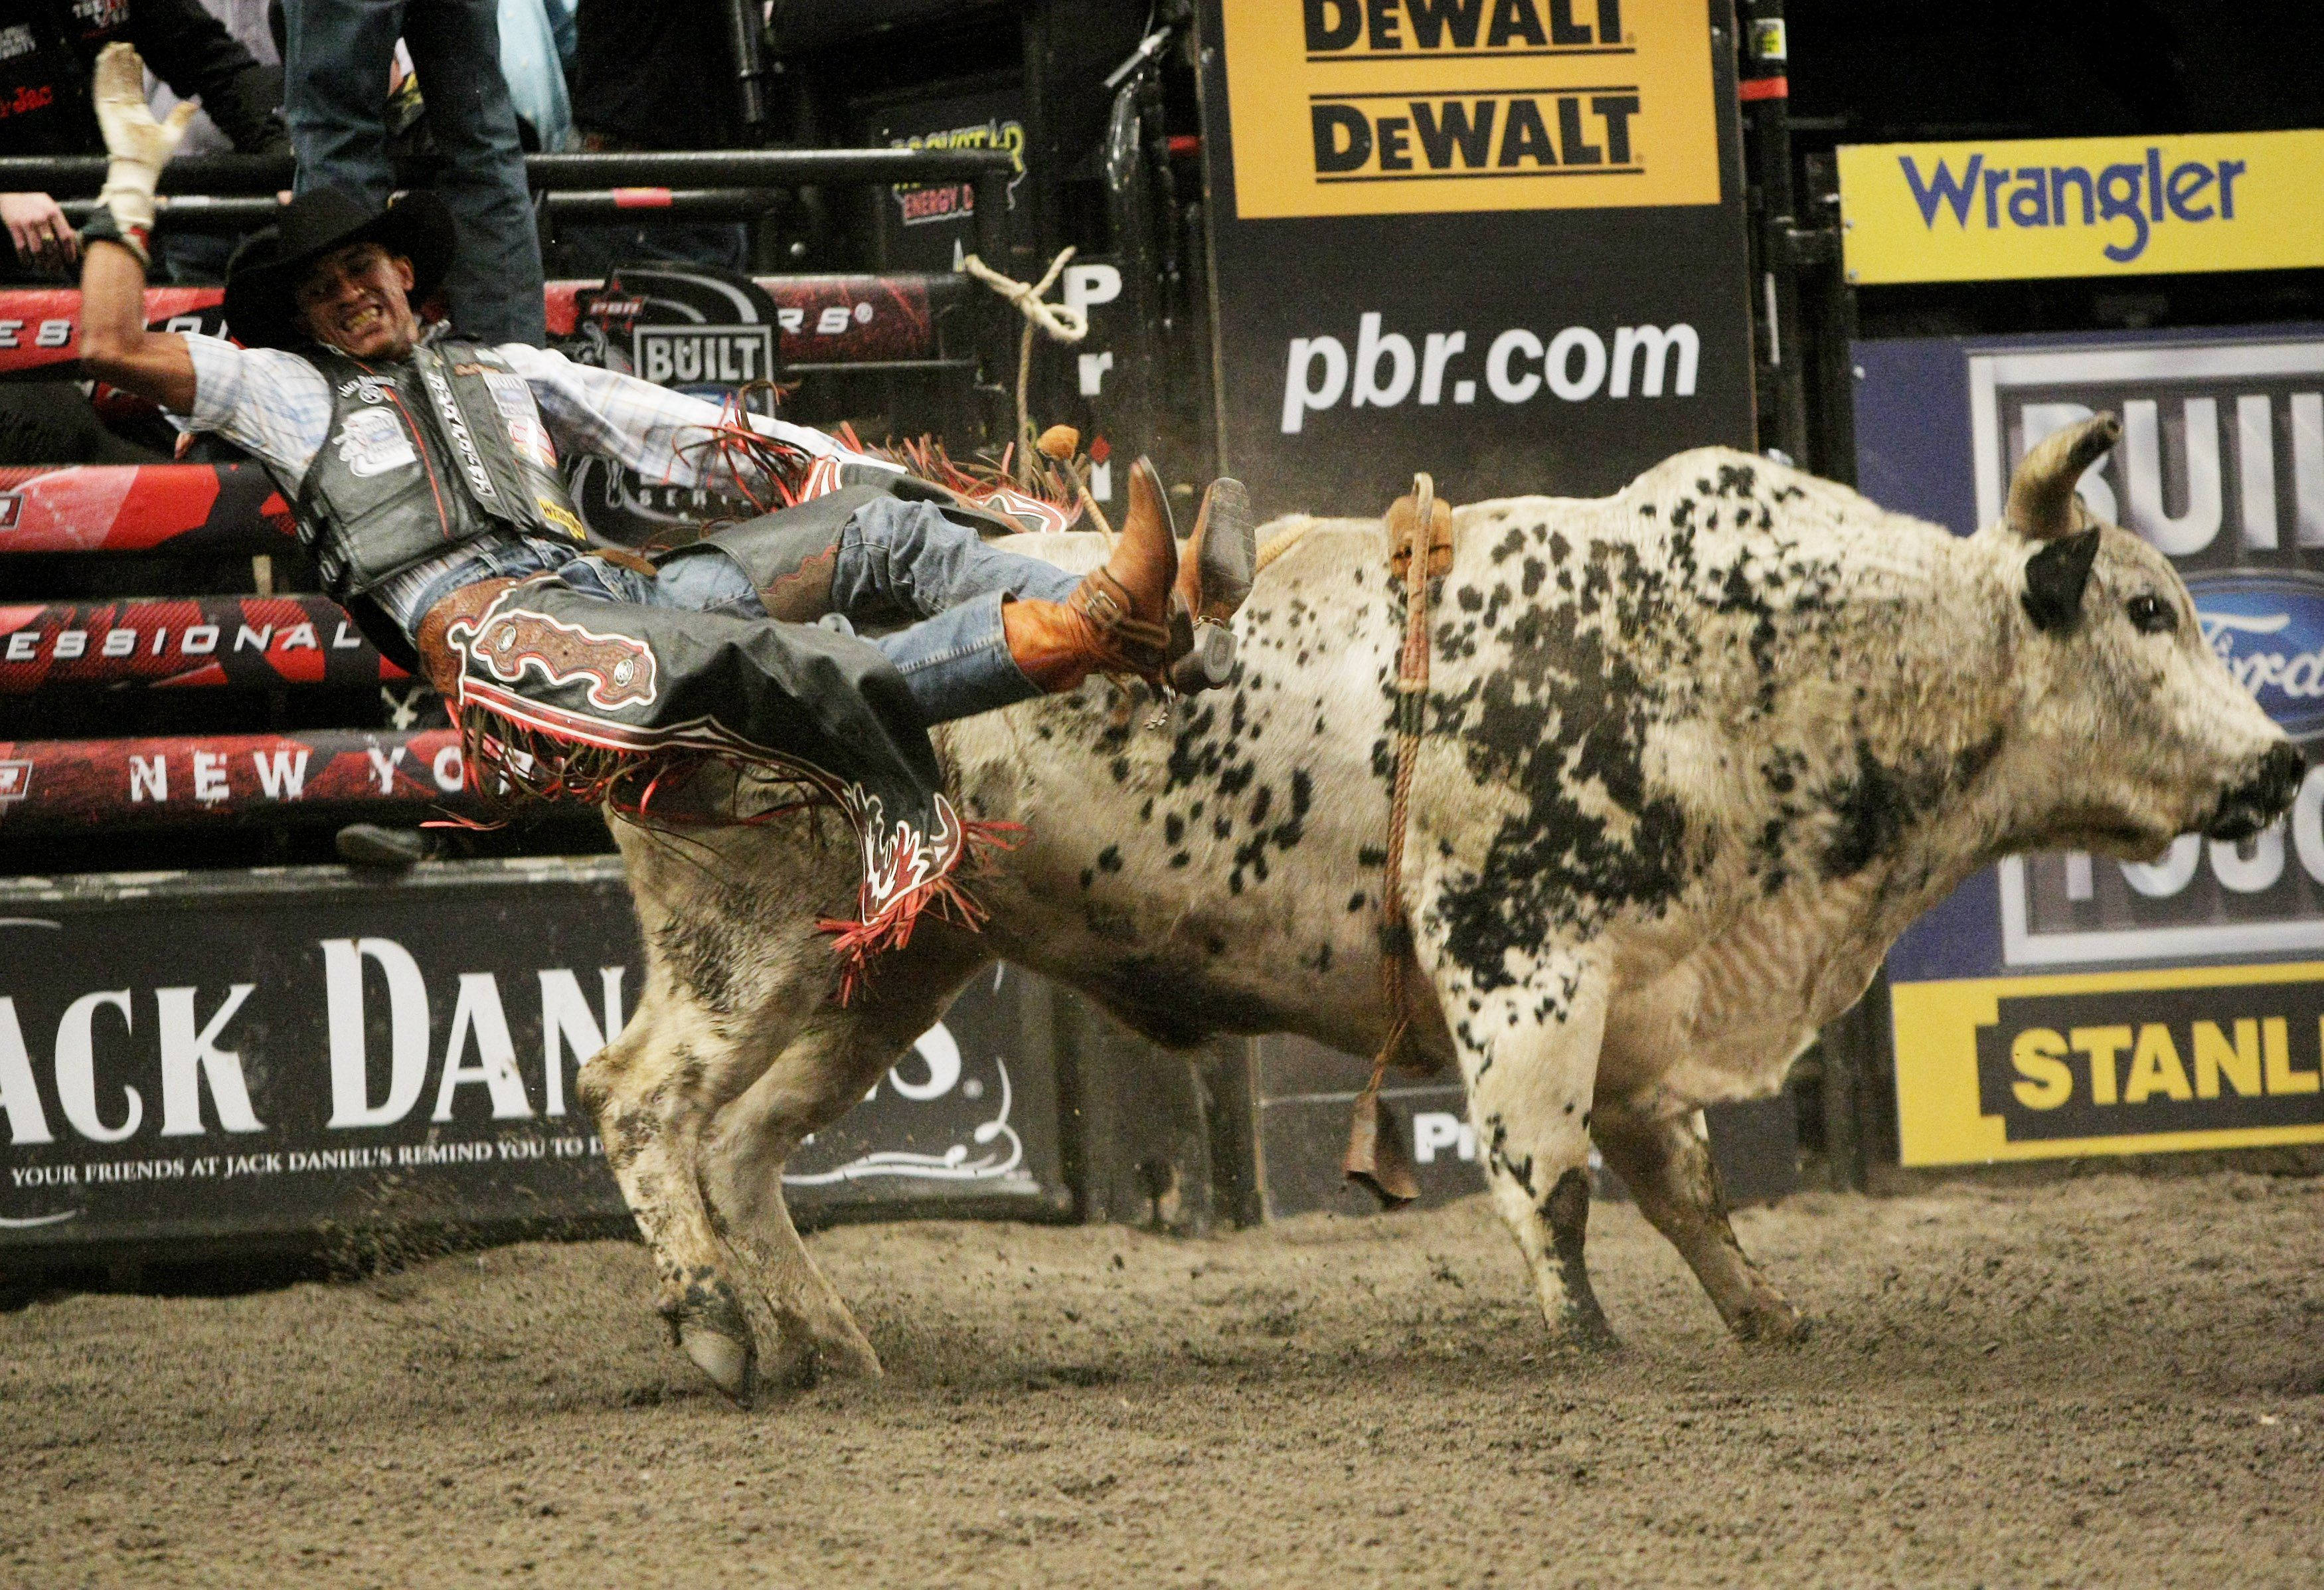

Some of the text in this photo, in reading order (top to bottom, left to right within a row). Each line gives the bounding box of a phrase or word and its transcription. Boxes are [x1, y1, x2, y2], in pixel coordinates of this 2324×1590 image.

[904, 187, 959, 219] ENERGY
[1898, 147, 2246, 263] Wrangler
[646, 335, 761, 381] BUILT
[1281, 312, 1700, 434] pbr.com
[5, 622, 362, 661] ESSIONAL
[129, 747, 309, 806] NEW
[2011, 1014, 2324, 1111] STANL
[12, 1164, 76, 1187] YOUR
[85, 1158, 185, 1184] FRIENDS
[191, 1156, 220, 1178] AT
[224, 1151, 283, 1180] JACK
[289, 1146, 392, 1172] DANIEL'S
[398, 1142, 493, 1166] REMIND
[497, 1137, 546, 1161] YOU
[550, 1136, 584, 1158] TO
